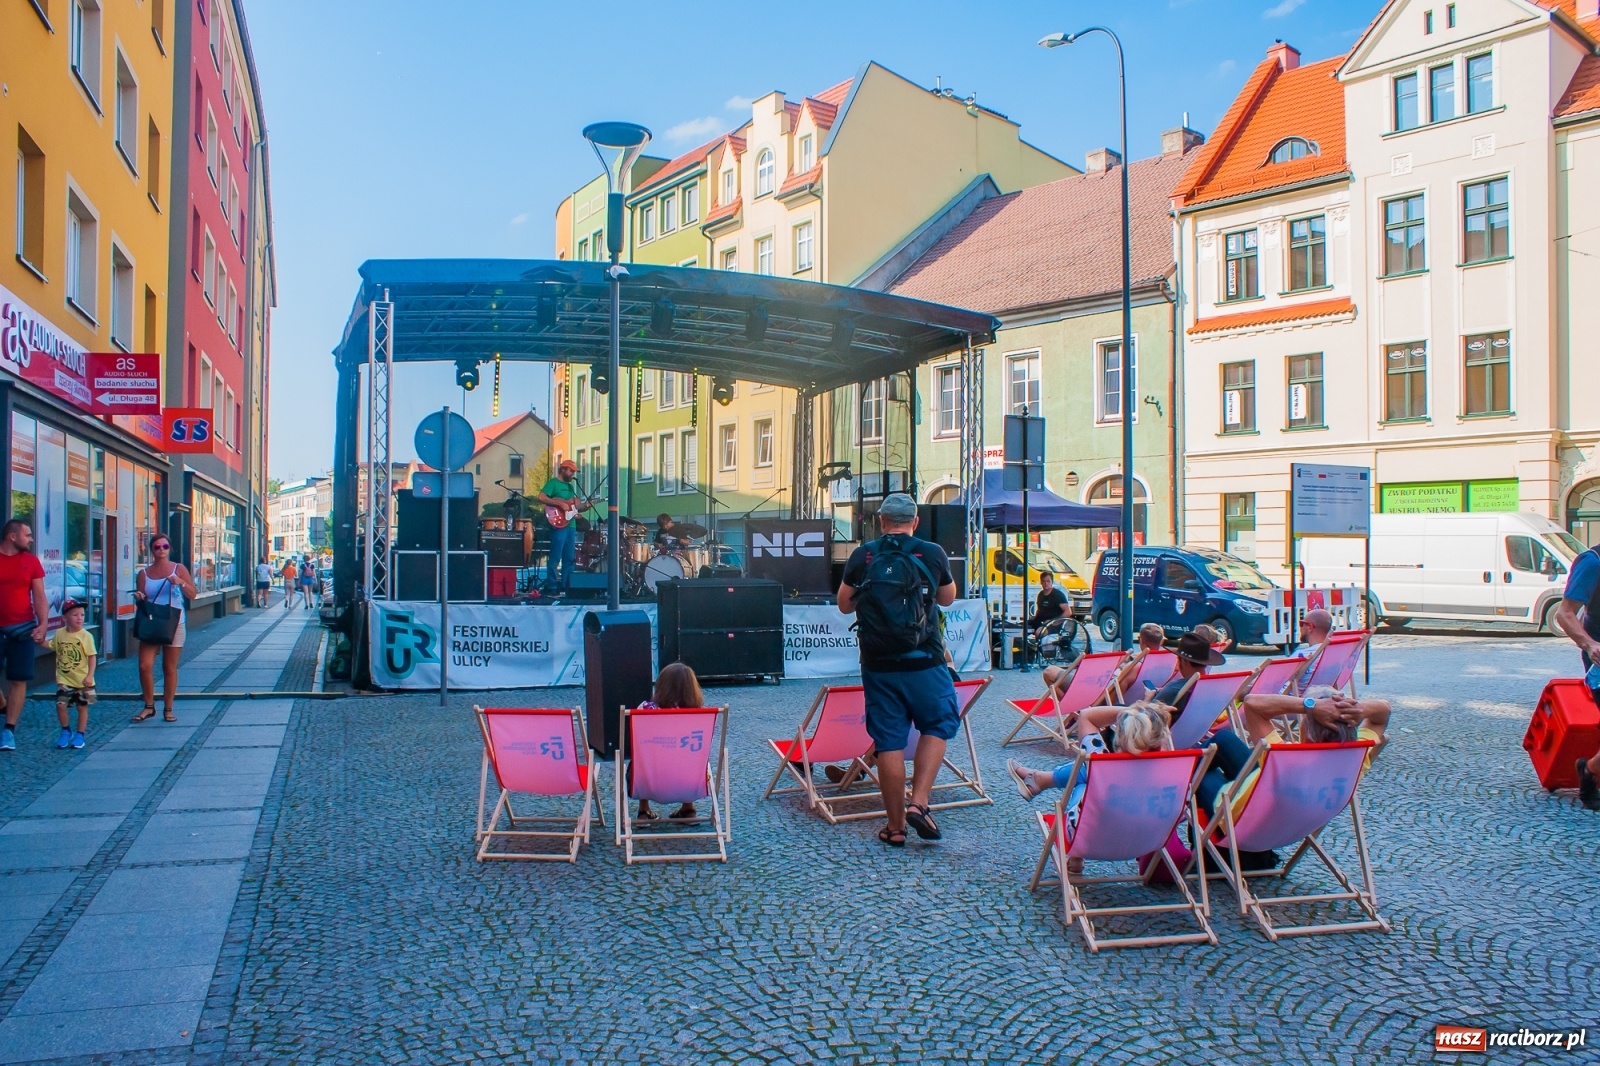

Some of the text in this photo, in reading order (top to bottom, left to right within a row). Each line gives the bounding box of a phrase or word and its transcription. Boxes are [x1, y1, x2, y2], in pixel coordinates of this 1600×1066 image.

[116, 357, 136, 370] as
[120, 395, 143, 403] Długa
[170, 417, 210, 443] STS
[983, 450, 1004, 458] SPRZ
[1387, 488, 1458, 497] ZWROT PODATKU
[1426, 506, 1457, 514] NIEMCY
[752, 531, 825, 557] NIC
[945, 609, 972, 623] YKA
[453, 625, 519, 639] FESTIWAL
[783, 624, 833, 635] ESTIWAL
[452, 640, 550, 653] RACIBORSKIEJ
[783, 637, 859, 648] ACIBORSKIEJ
[452, 655, 492, 667] ULICY
[784, 650, 812, 661] LICY
